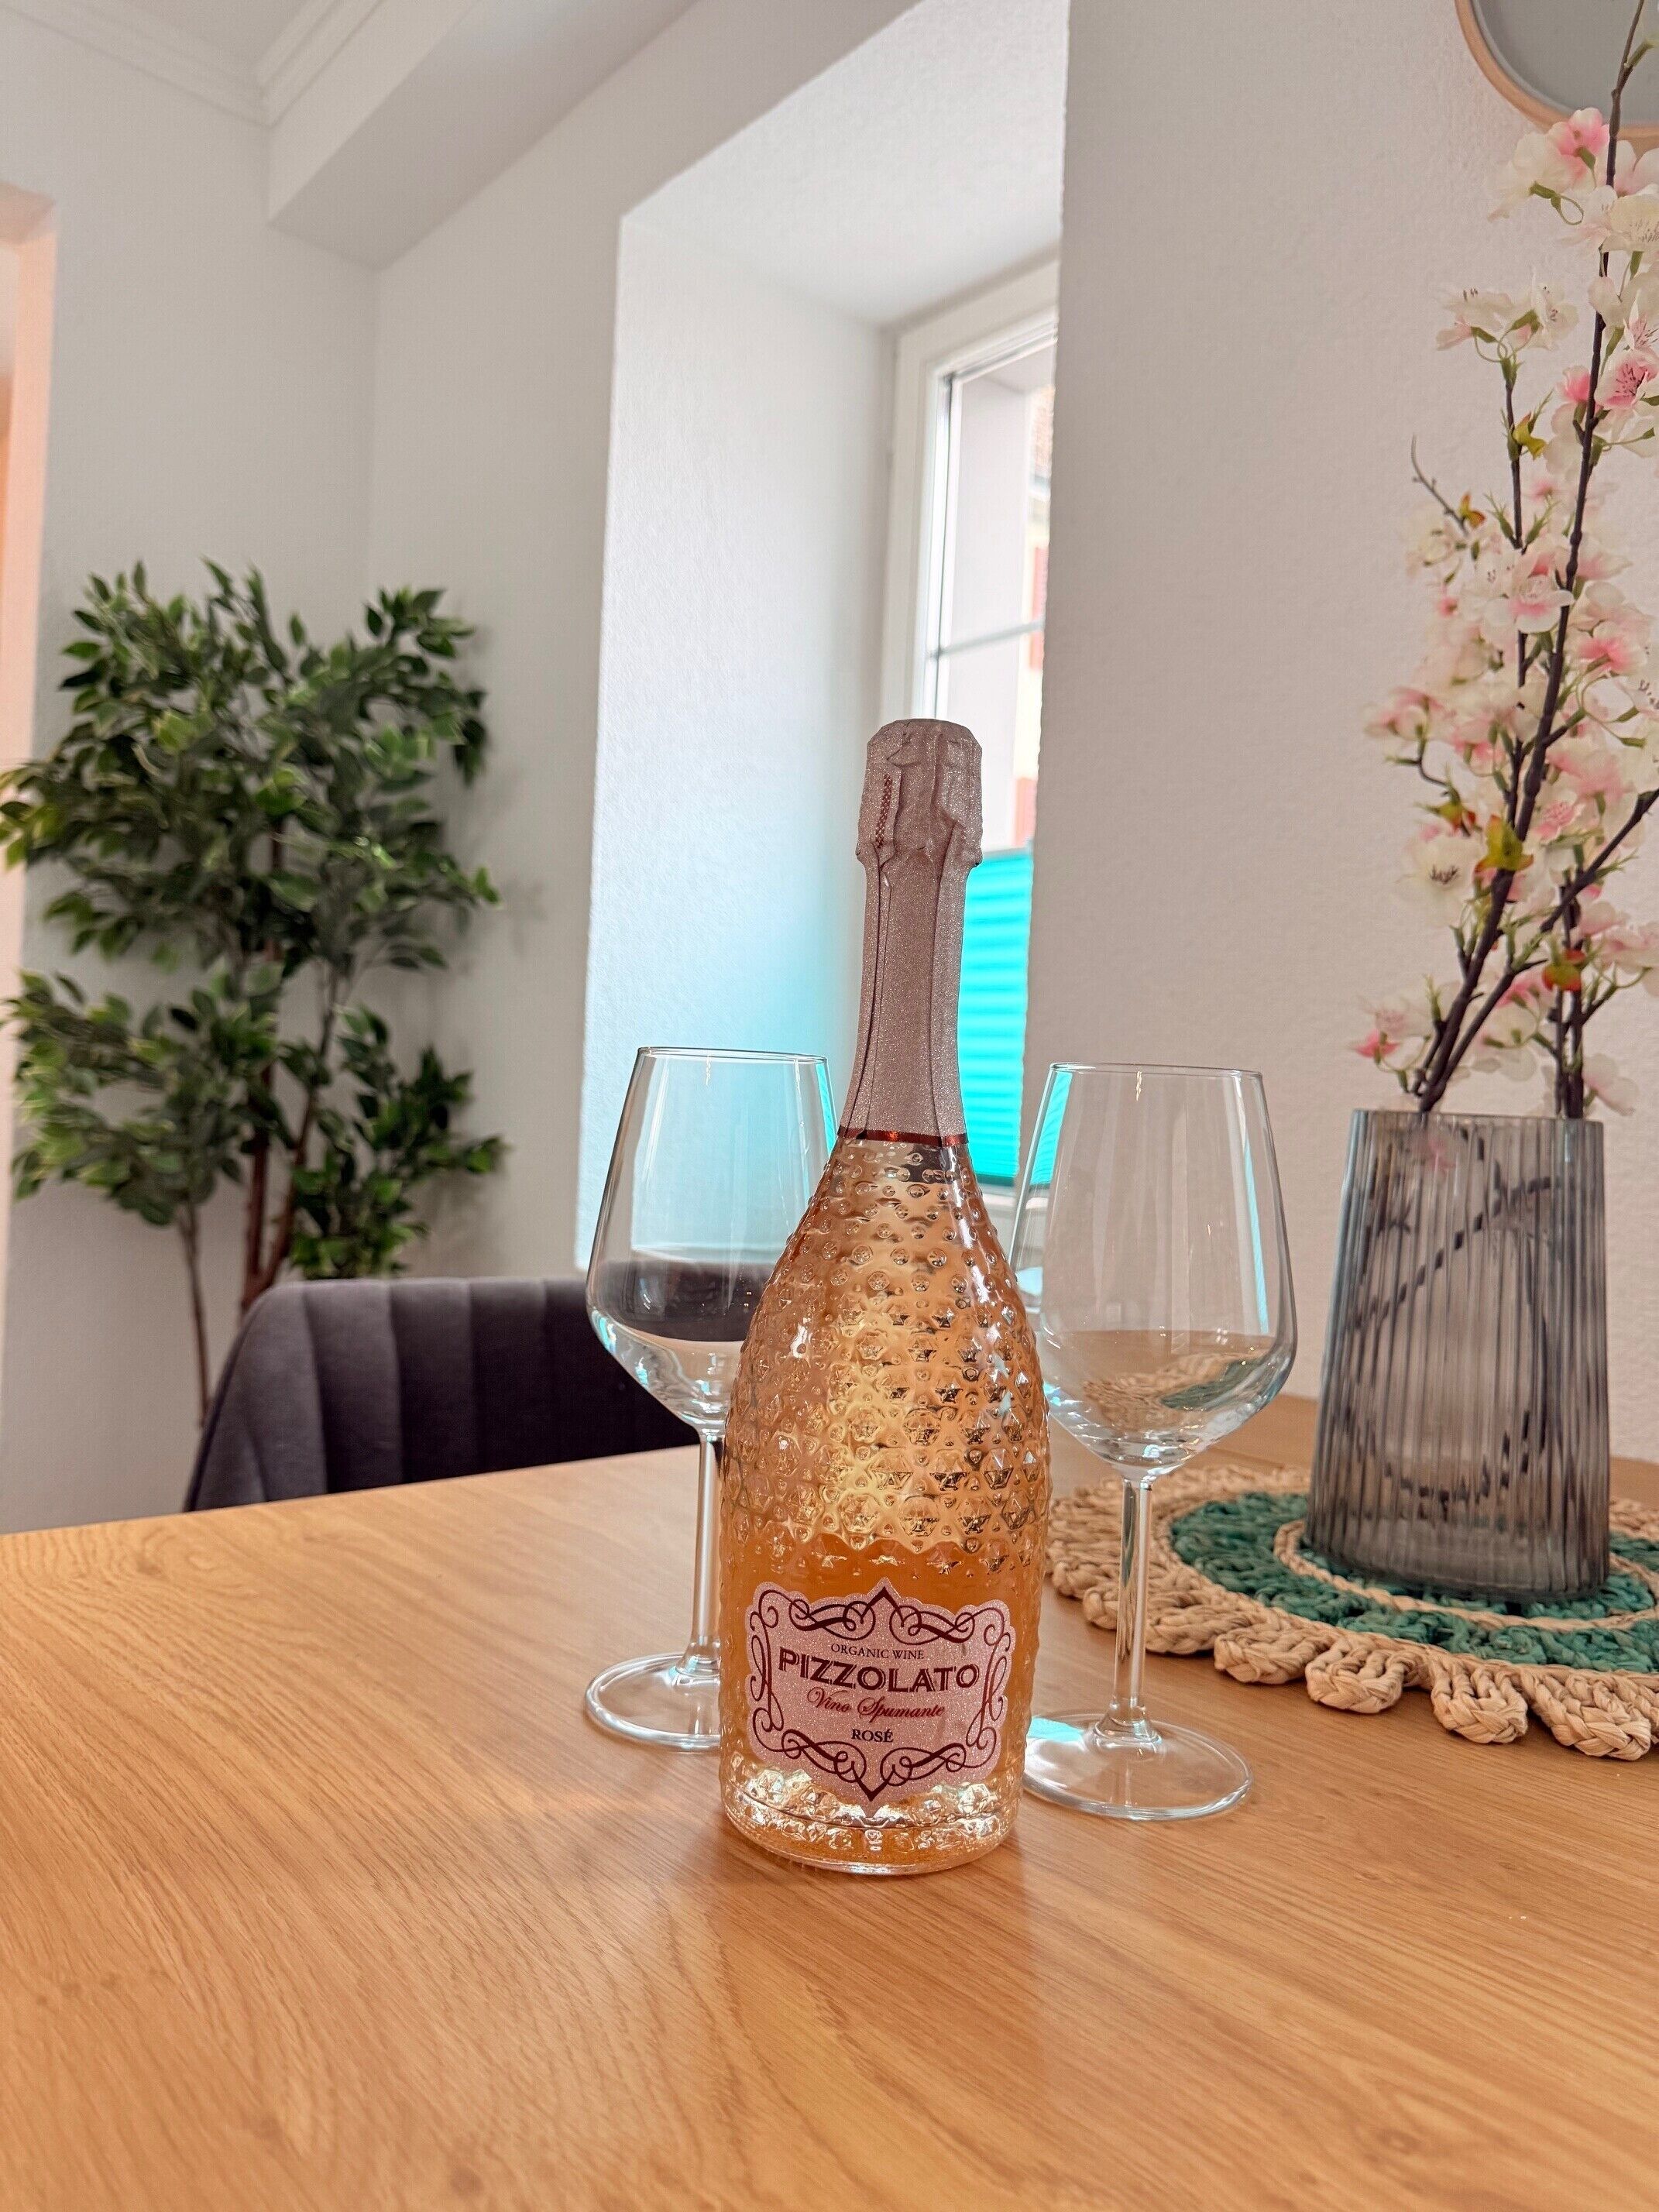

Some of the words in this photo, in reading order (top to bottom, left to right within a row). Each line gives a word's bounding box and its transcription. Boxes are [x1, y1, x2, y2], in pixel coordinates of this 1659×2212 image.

[831, 1643, 889, 1658] ORGANIC
[892, 1649, 925, 1660] WINE
[778, 1647, 981, 1692] PIZZOLATO
[807, 1686, 853, 1712] Vino
[857, 1697, 946, 1723] Spumante
[851, 1728, 894, 1743] ROSÉ
